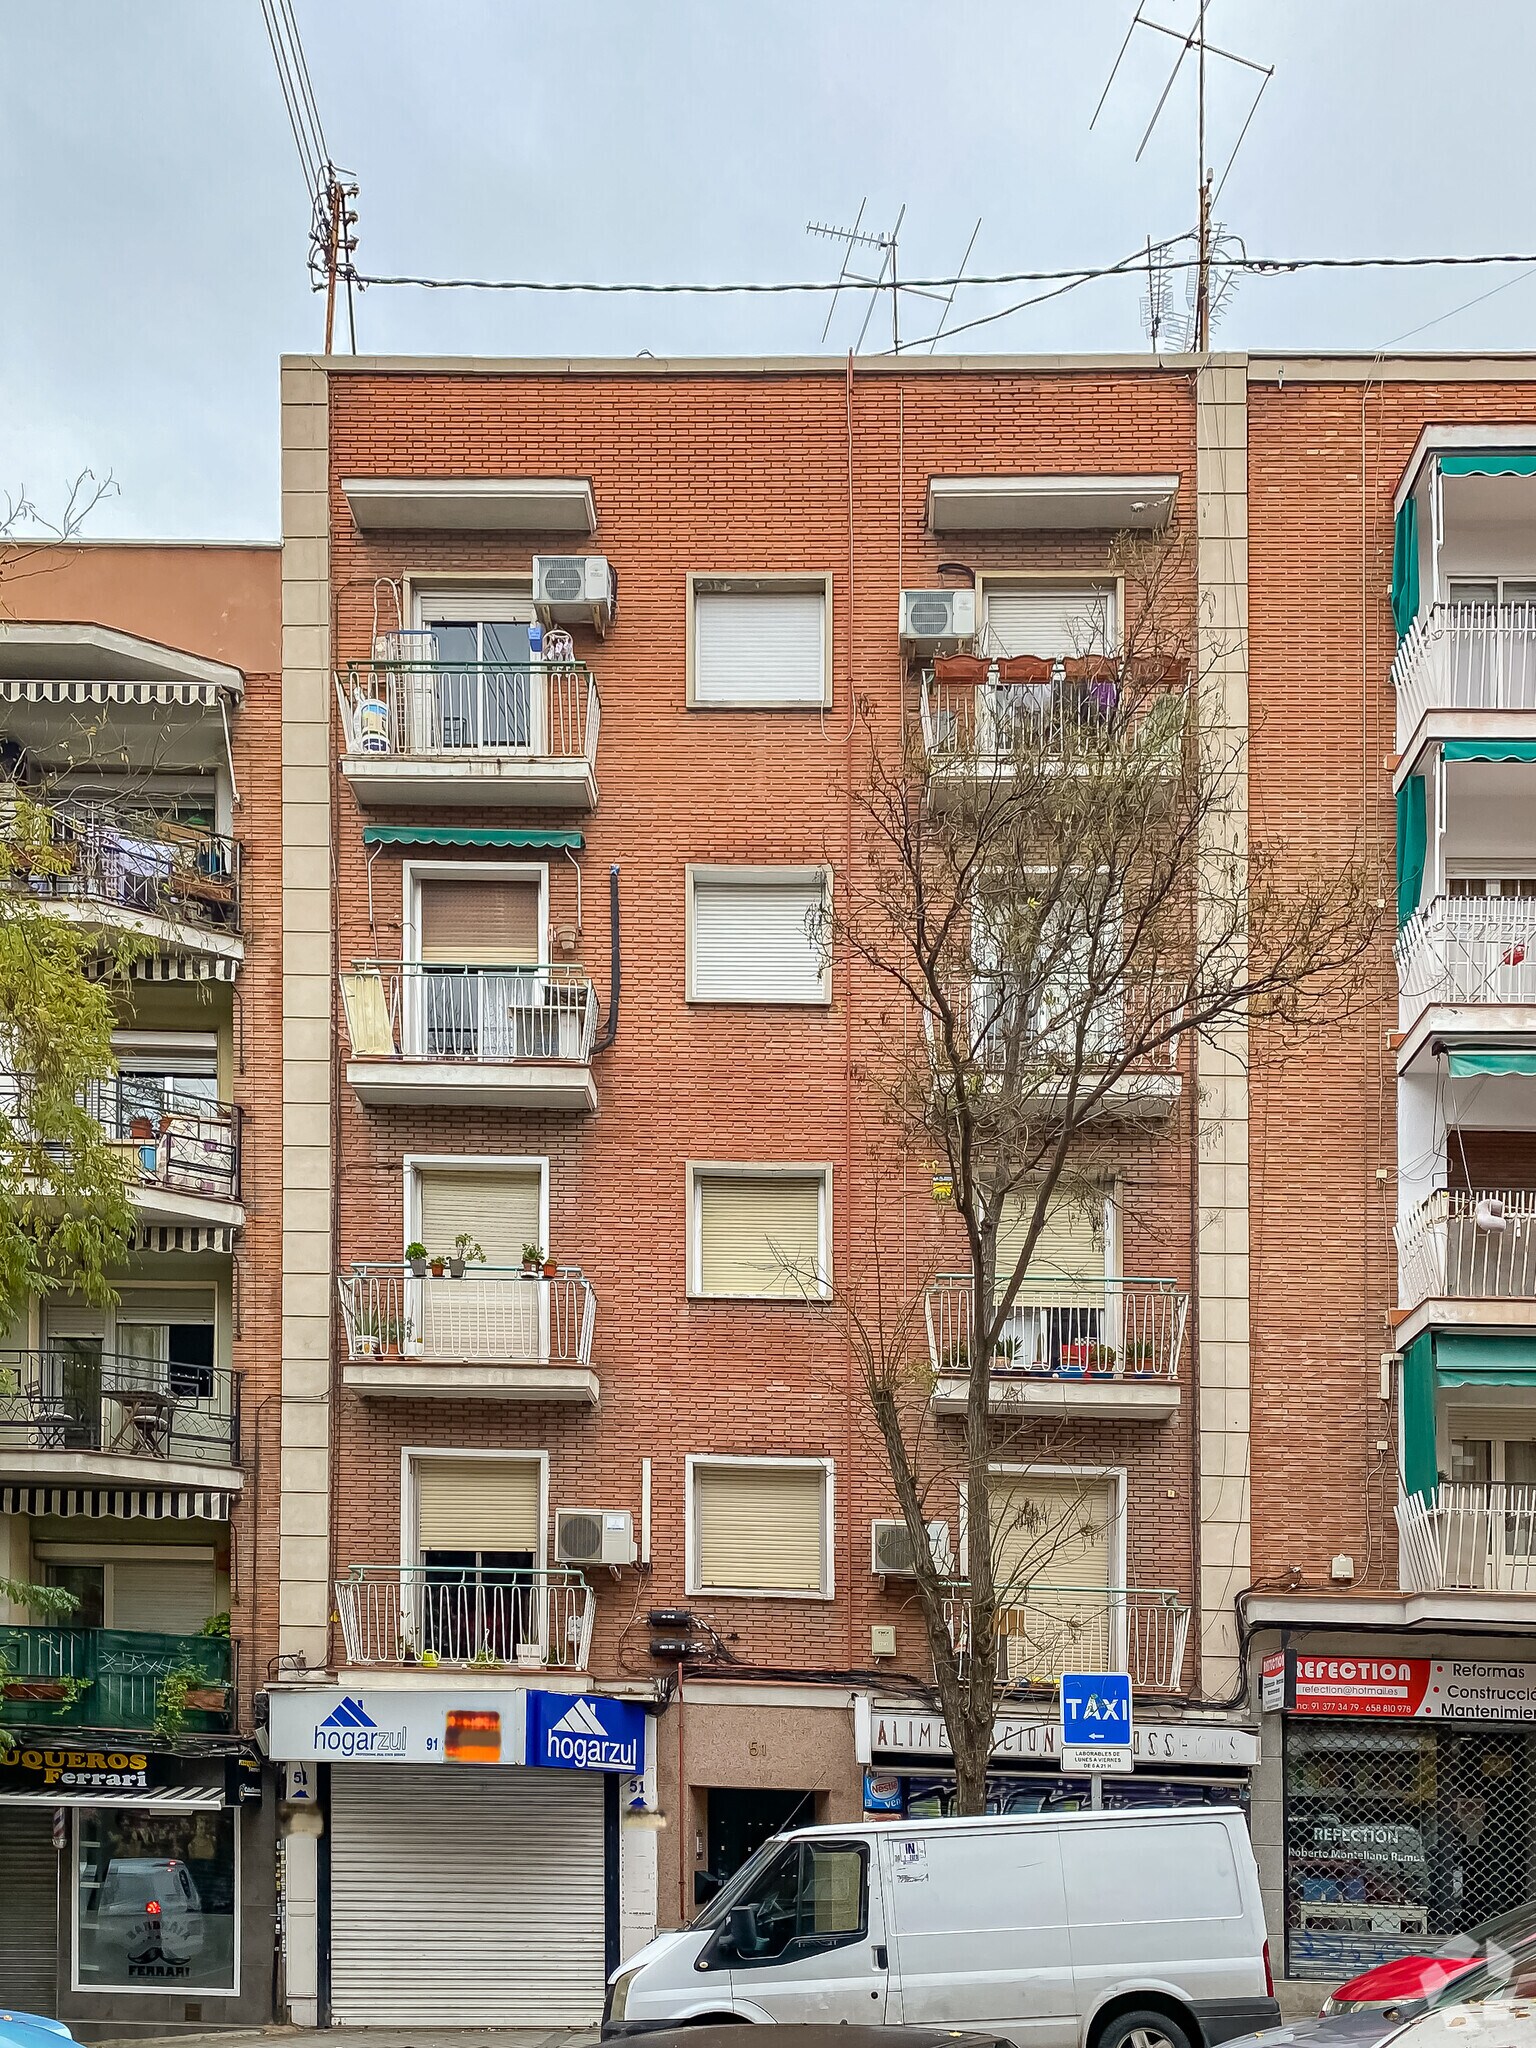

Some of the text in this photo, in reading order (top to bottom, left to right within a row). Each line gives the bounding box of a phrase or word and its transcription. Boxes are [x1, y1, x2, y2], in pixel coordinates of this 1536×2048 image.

[1296, 1661, 1411, 1681] REFECTION
[1453, 1663, 1525, 1678] Reformas
[1066, 1698, 1127, 1720] TAXI
[1311, 1702, 1319, 1710] 91
[1323, 1702, 1336, 1711] 377
[1338, 1702, 1347, 1711] 34
[1350, 1703, 1359, 1711] 79
[1365, 1704, 1381, 1712] 658
[1382, 1704, 1396, 1713] 810
[1397, 1705, 1411, 1713] 978
[1441, 1703, 1536, 1719] Mantenimie
[314, 1725, 407, 1756] hogarzul
[426, 1738, 438, 1751] 91
[547, 1728, 637, 1768] hogarzul
[749, 1741, 767, 1757] 51
[44, 1768, 147, 1787] Ferrari
[629, 1780, 645, 1794] 51
